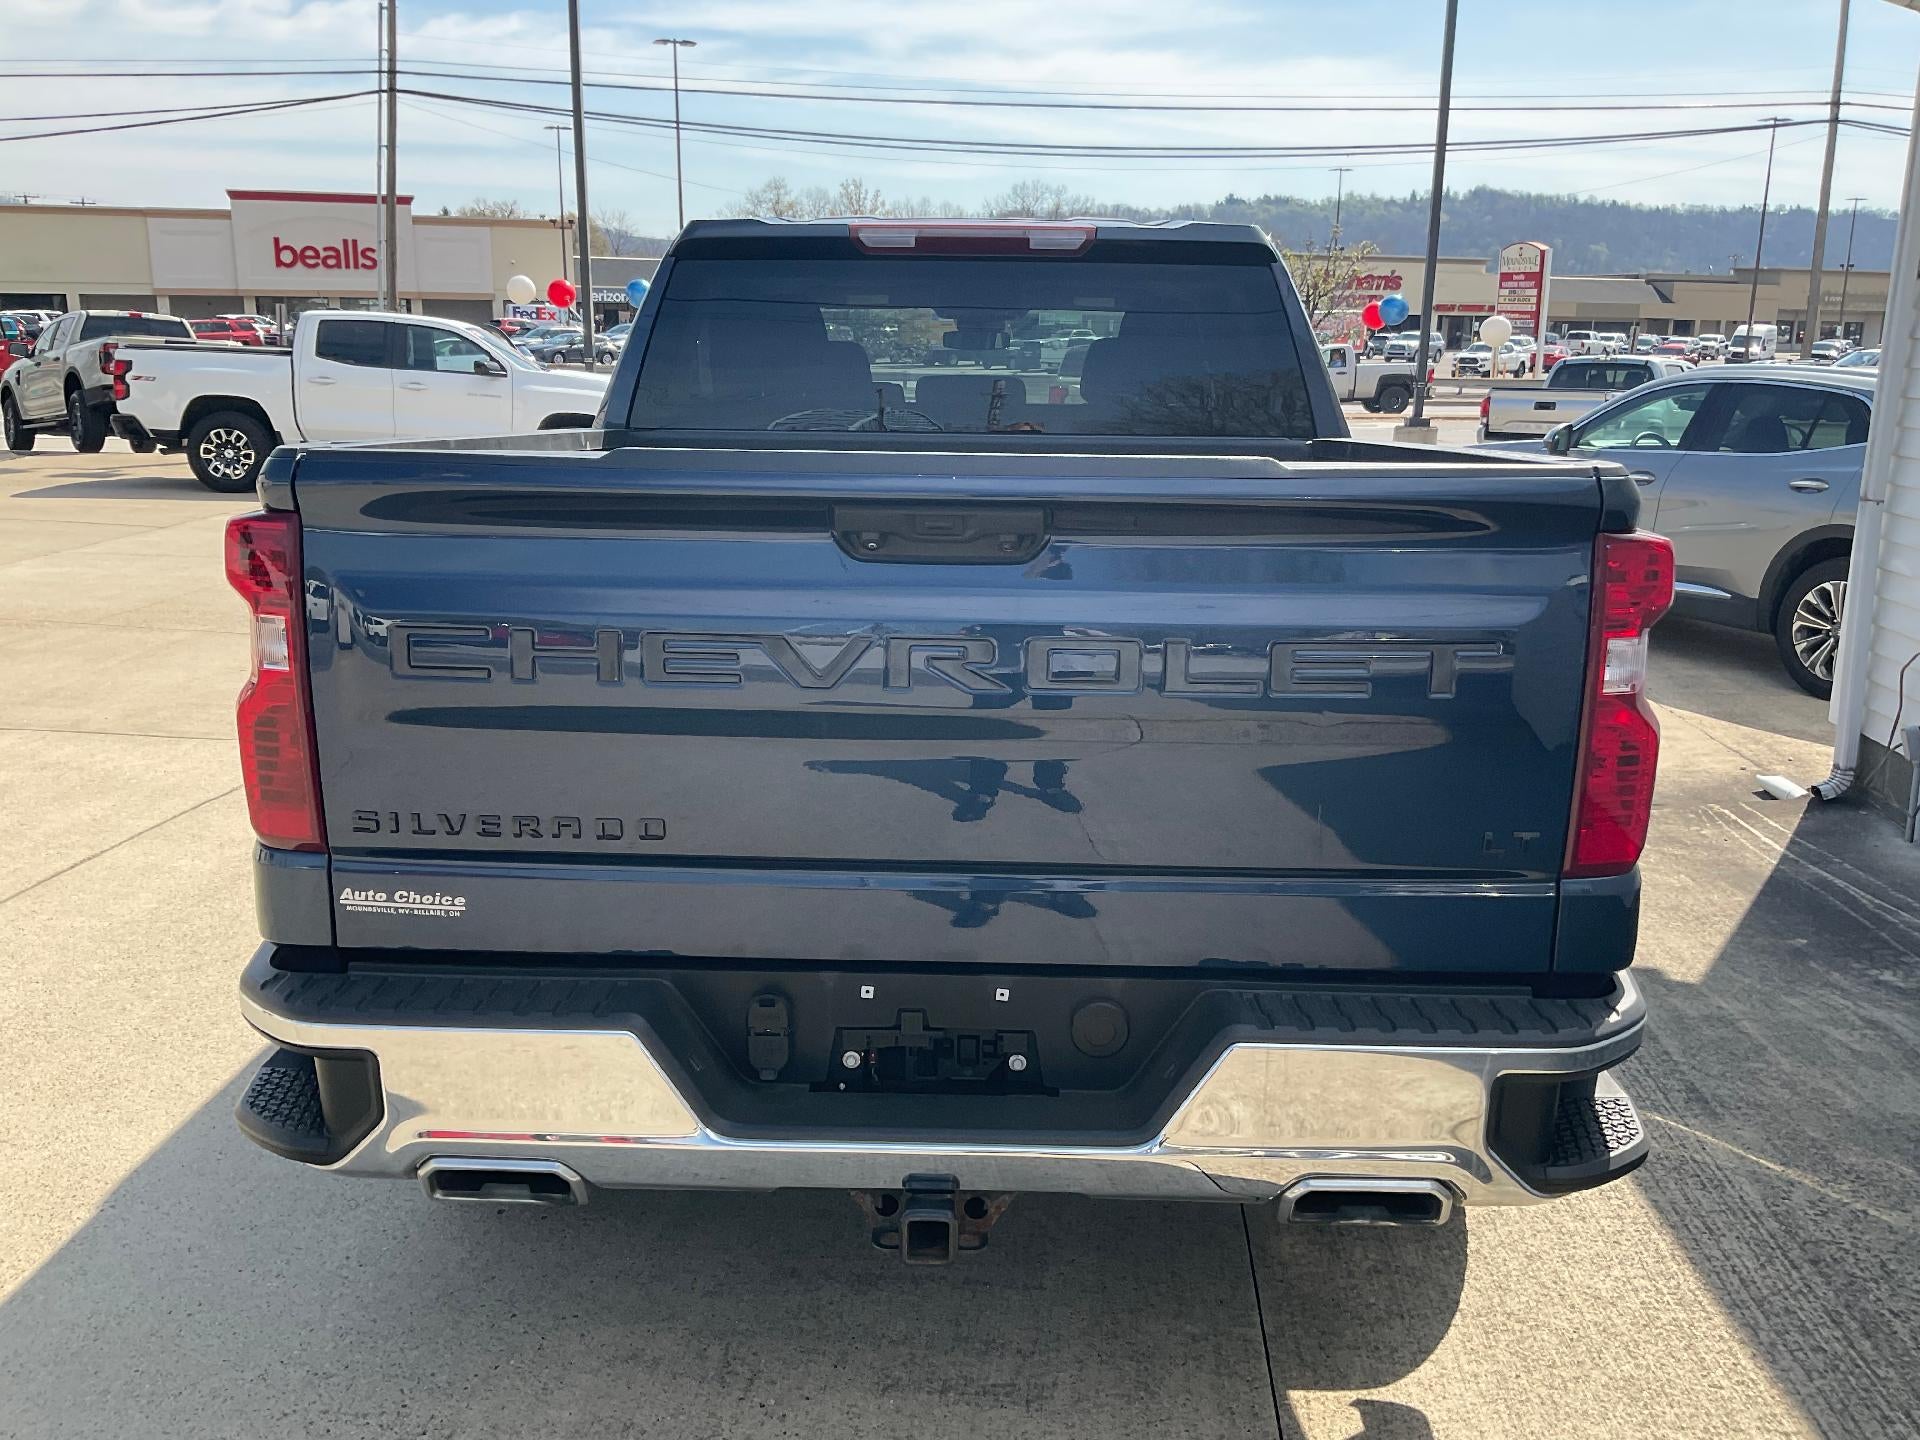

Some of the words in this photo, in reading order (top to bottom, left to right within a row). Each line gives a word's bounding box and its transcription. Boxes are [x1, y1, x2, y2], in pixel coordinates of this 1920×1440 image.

[273, 236, 378, 270] bealls
[592, 290, 629, 302] erizon
[512, 306, 557, 321] FedEx
[389, 622, 1504, 700] CHEVROLET
[352, 810, 668, 841] SILVERADO
[1483, 831, 1541, 854] LT
[340, 888, 387, 902] Auto
[394, 890, 466, 906] Choice
[346, 905, 397, 914] MOUNDSVILLE,
